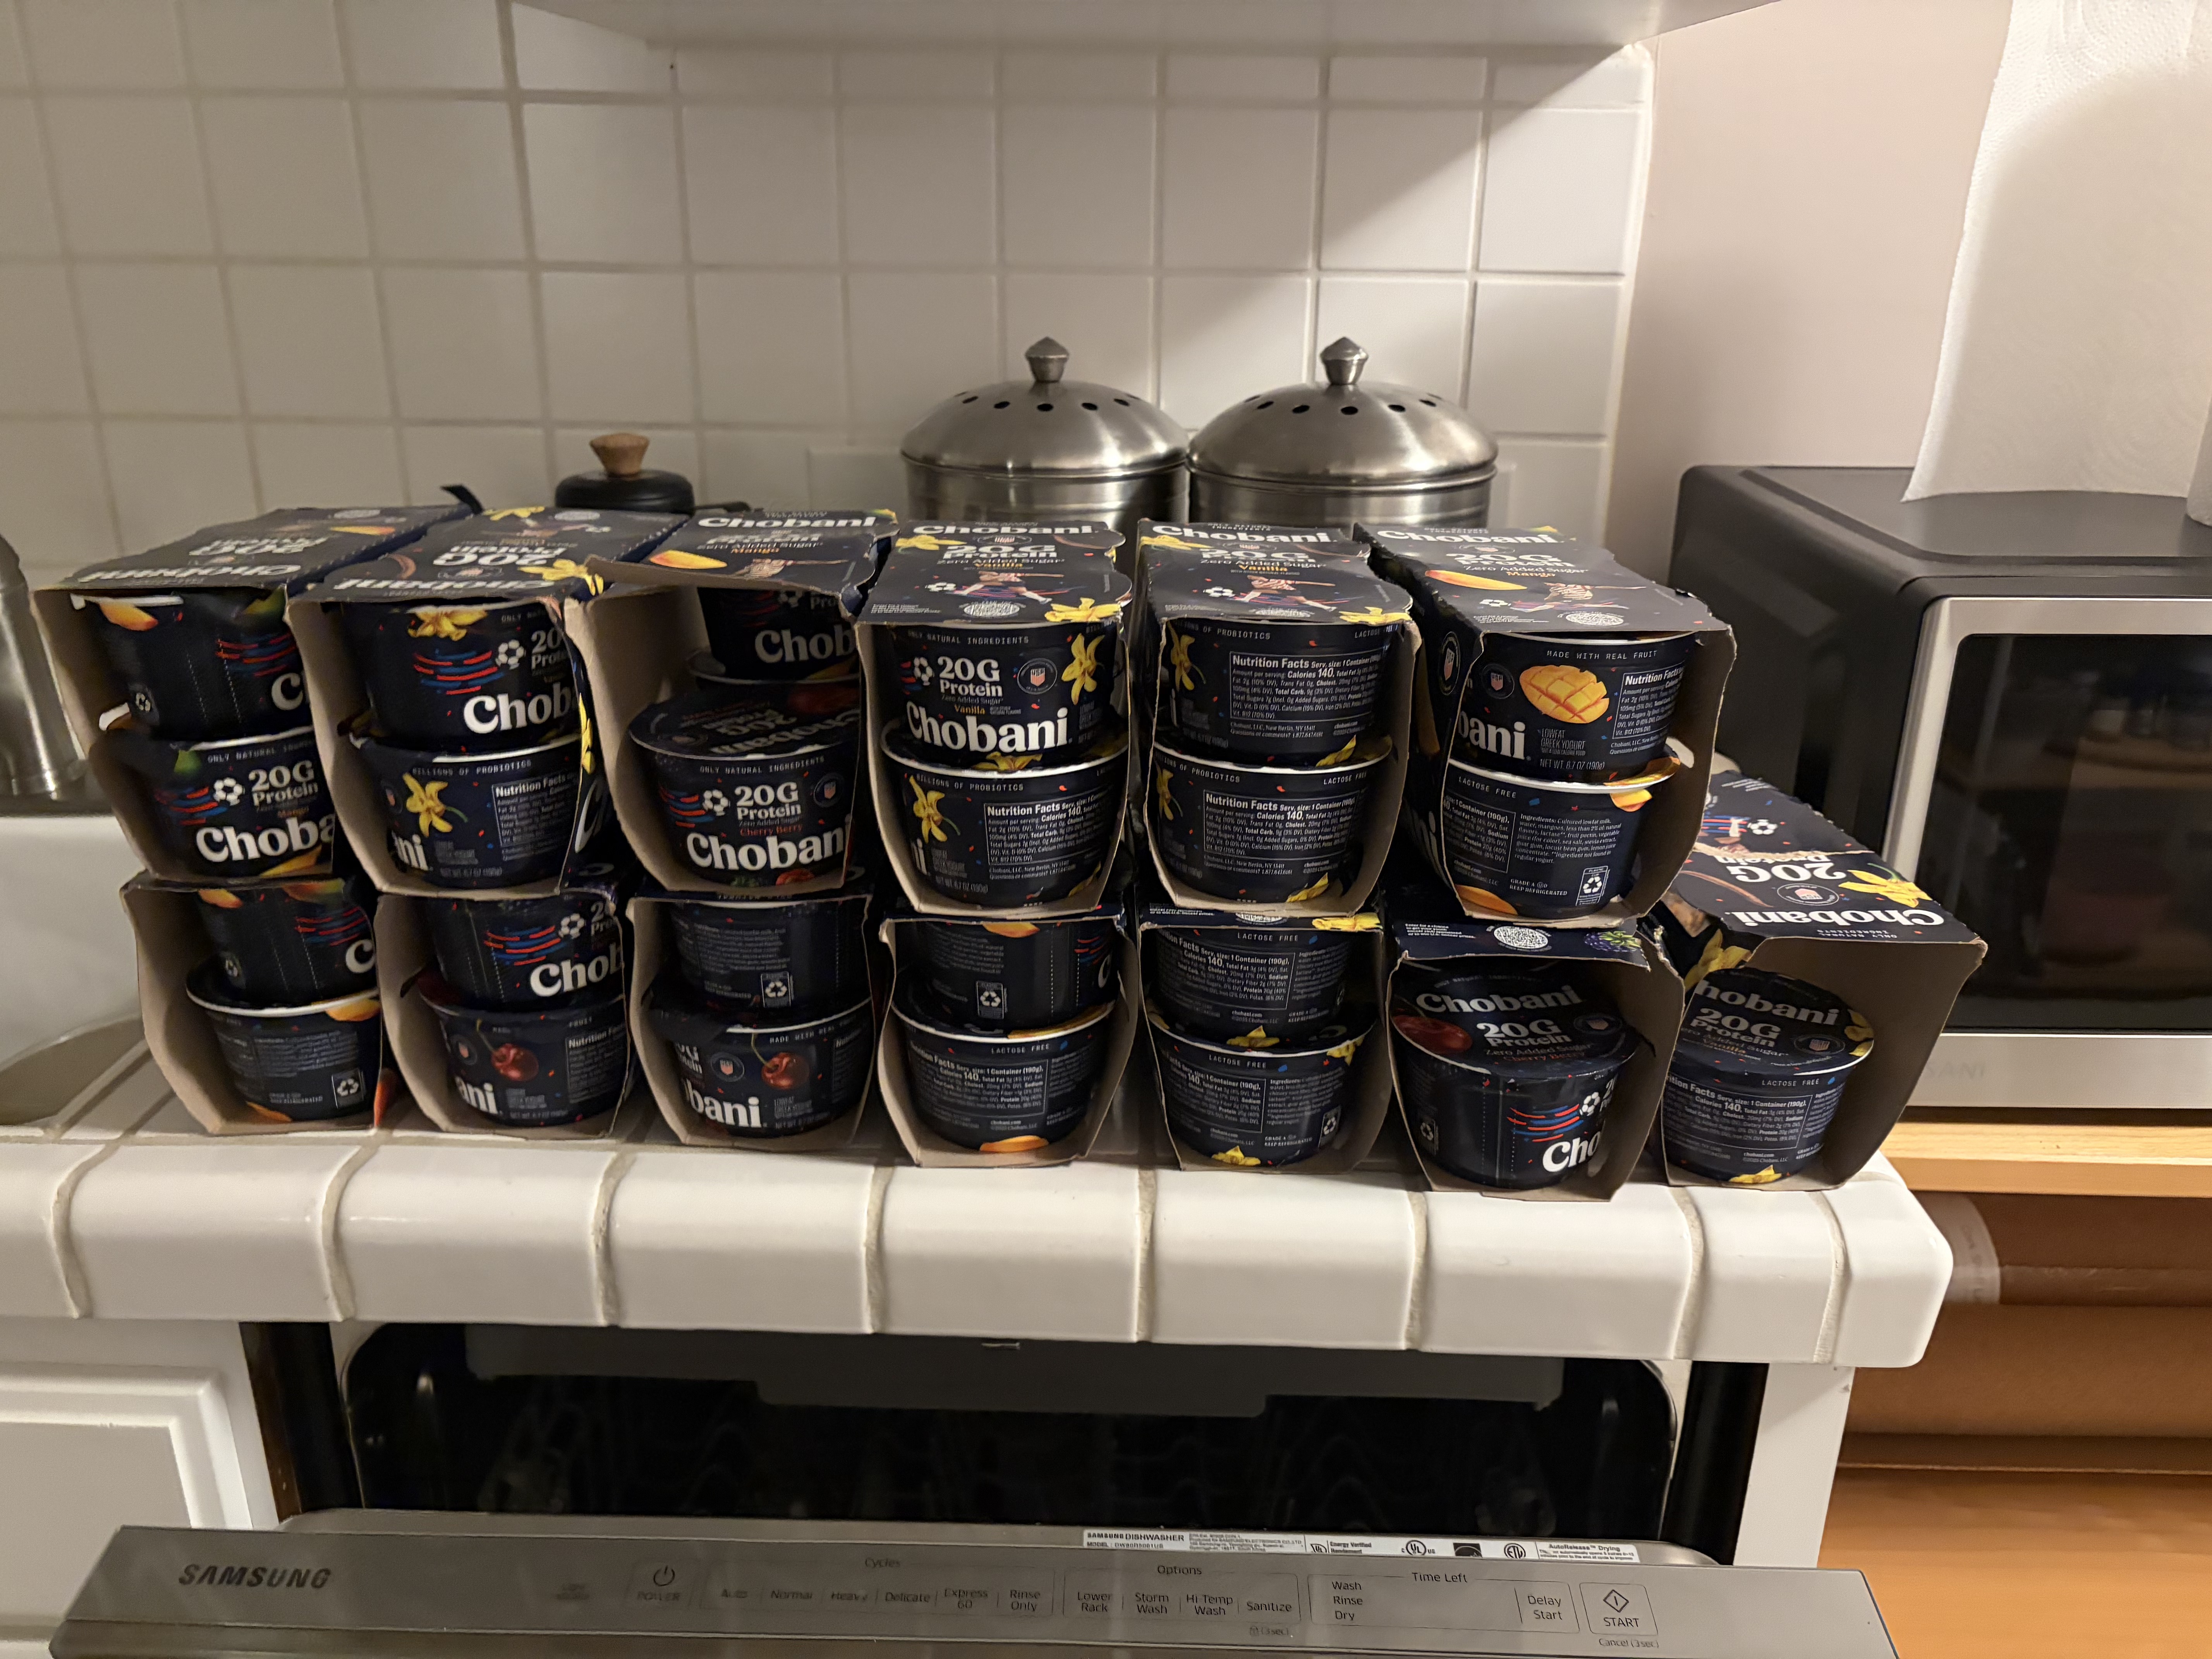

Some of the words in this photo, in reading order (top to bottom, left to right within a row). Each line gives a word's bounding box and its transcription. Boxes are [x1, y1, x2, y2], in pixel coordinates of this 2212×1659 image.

[698, 517, 876, 528] Chobani
[913, 526, 1092, 534] Chobani
[1152, 526, 1332, 543] Chobani
[1377, 530, 1558, 543] Chobani
[947, 545, 1056, 553] 20G
[1200, 548, 1309, 559] 20G
[1446, 553, 1562, 562] 20G
[1217, 628, 1271, 640] PROBIOTICS
[531, 630, 562, 652] 20
[754, 625, 852, 664] Chob
[927, 635, 961, 644] NATURAL
[967, 637, 1029, 645] INGREDIENTS
[1547, 650, 1570, 659] MADE
[1606, 651, 1627, 660] REAL
[1633, 650, 1658, 659] FRUIT
[1233, 655, 1278, 668] Nutrition
[1281, 658, 1309, 668] Facts
[937, 656, 1000, 682] 20G
[1318, 668, 1334, 678] 140,
[1625, 673, 1663, 685] Nutrition
[1664, 668, 1679, 680] Facts
[940, 680, 1003, 697] Protein
[464, 682, 578, 734] Chob
[954, 704, 986, 715] Vanilla
[906, 700, 1068, 752] Chobani
[1458, 710, 1526, 761] bani
[1542, 728, 1565, 738] LOWFAT
[249, 760, 315, 791] 20G
[700, 766, 719, 774] ONLY
[1192, 768, 1240, 783] PROBIOTICS
[1324, 775, 1352, 785] LACTOSE
[495, 778, 541, 797] Nutrition
[970, 783, 1024, 792] PROBIOTICS
[1458, 776, 1490, 792] LACTOSE
[1496, 788, 1516, 799] FREE
[252, 781, 318, 806] Protein
[734, 781, 799, 807] 20G
[1206, 793, 1248, 809] Nutrition
[1251, 800, 1278, 811] Facts
[1315, 801, 1341, 810] Container
[737, 803, 802, 821] Protein
[988, 806, 1032, 816] Nutrition
[1036, 803, 1060, 814] Facts
[1459, 800, 1486, 816] Container
[1041, 813, 1066, 822] Calories
[1257, 812, 1285, 820] Calories
[1286, 811, 1304, 820] 140,
[1521, 814, 1556, 823] Ingredients:
[740, 828, 774, 836] Cherry
[196, 814, 336, 862] Choba
[1726, 862, 1846, 883] 20G
[1525, 887, 1567, 896] REFRIGERATED
[1729, 909, 1944, 926] Chobani
[1238, 933, 1273, 941] LACTOSE
[1179, 938, 1199, 952] Facts
[1208, 957, 1224, 968] 140,
[1416, 984, 1583, 1013] Chobani
[1693, 979, 1840, 1025] hobani
[1476, 1018, 1562, 1038] 20G
[1695, 1008, 1781, 1039] 20G
[1690, 1018, 1776, 1048] Protein
[1486, 1034, 1573, 1047] Protein
[1032, 1043, 1049, 1052] FREE
[1209, 1054, 1241, 1066] LACTOSE
[1690, 1084, 1715, 1099] Facts
[685, 1077, 763, 1128] bani
[1695, 1096, 1722, 1109] Calories
[1125, 1534, 1185, 1542] DISHWASHER
[865, 1557, 901, 1568] Cycles
[1157, 1565, 1202, 1575] Options
[178, 1563, 331, 1589] SAMSUNG
[1412, 1572, 1441, 1582] Time
[1444, 1573, 1468, 1583] Left
[1332, 1581, 1362, 1590] Wash
[885, 1592, 930, 1603] Delicate
[944, 1588, 989, 1599] Express
[1010, 1589, 1041, 1599] Rinse
[1077, 1591, 1112, 1601] Lower
[1135, 1592, 1169, 1603] Storm
[958, 1599, 973, 1609] 60
[1202, 1594, 1233, 1606] Temp
[1333, 1595, 1363, 1606] Rinse
[1528, 1594, 1561, 1607] Delay
[1011, 1601, 1037, 1612] Only
[1081, 1602, 1108, 1613] Rack
[1137, 1604, 1167, 1615] Wash
[1194, 1605, 1226, 1616] Wash
[1247, 1601, 1292, 1612] Sanitize
[1334, 1610, 1355, 1621] Dry
[1533, 1610, 1563, 1621] Start
[1603, 1617, 1640, 1628] START
[1599, 1638, 1629, 1647] Cancel
